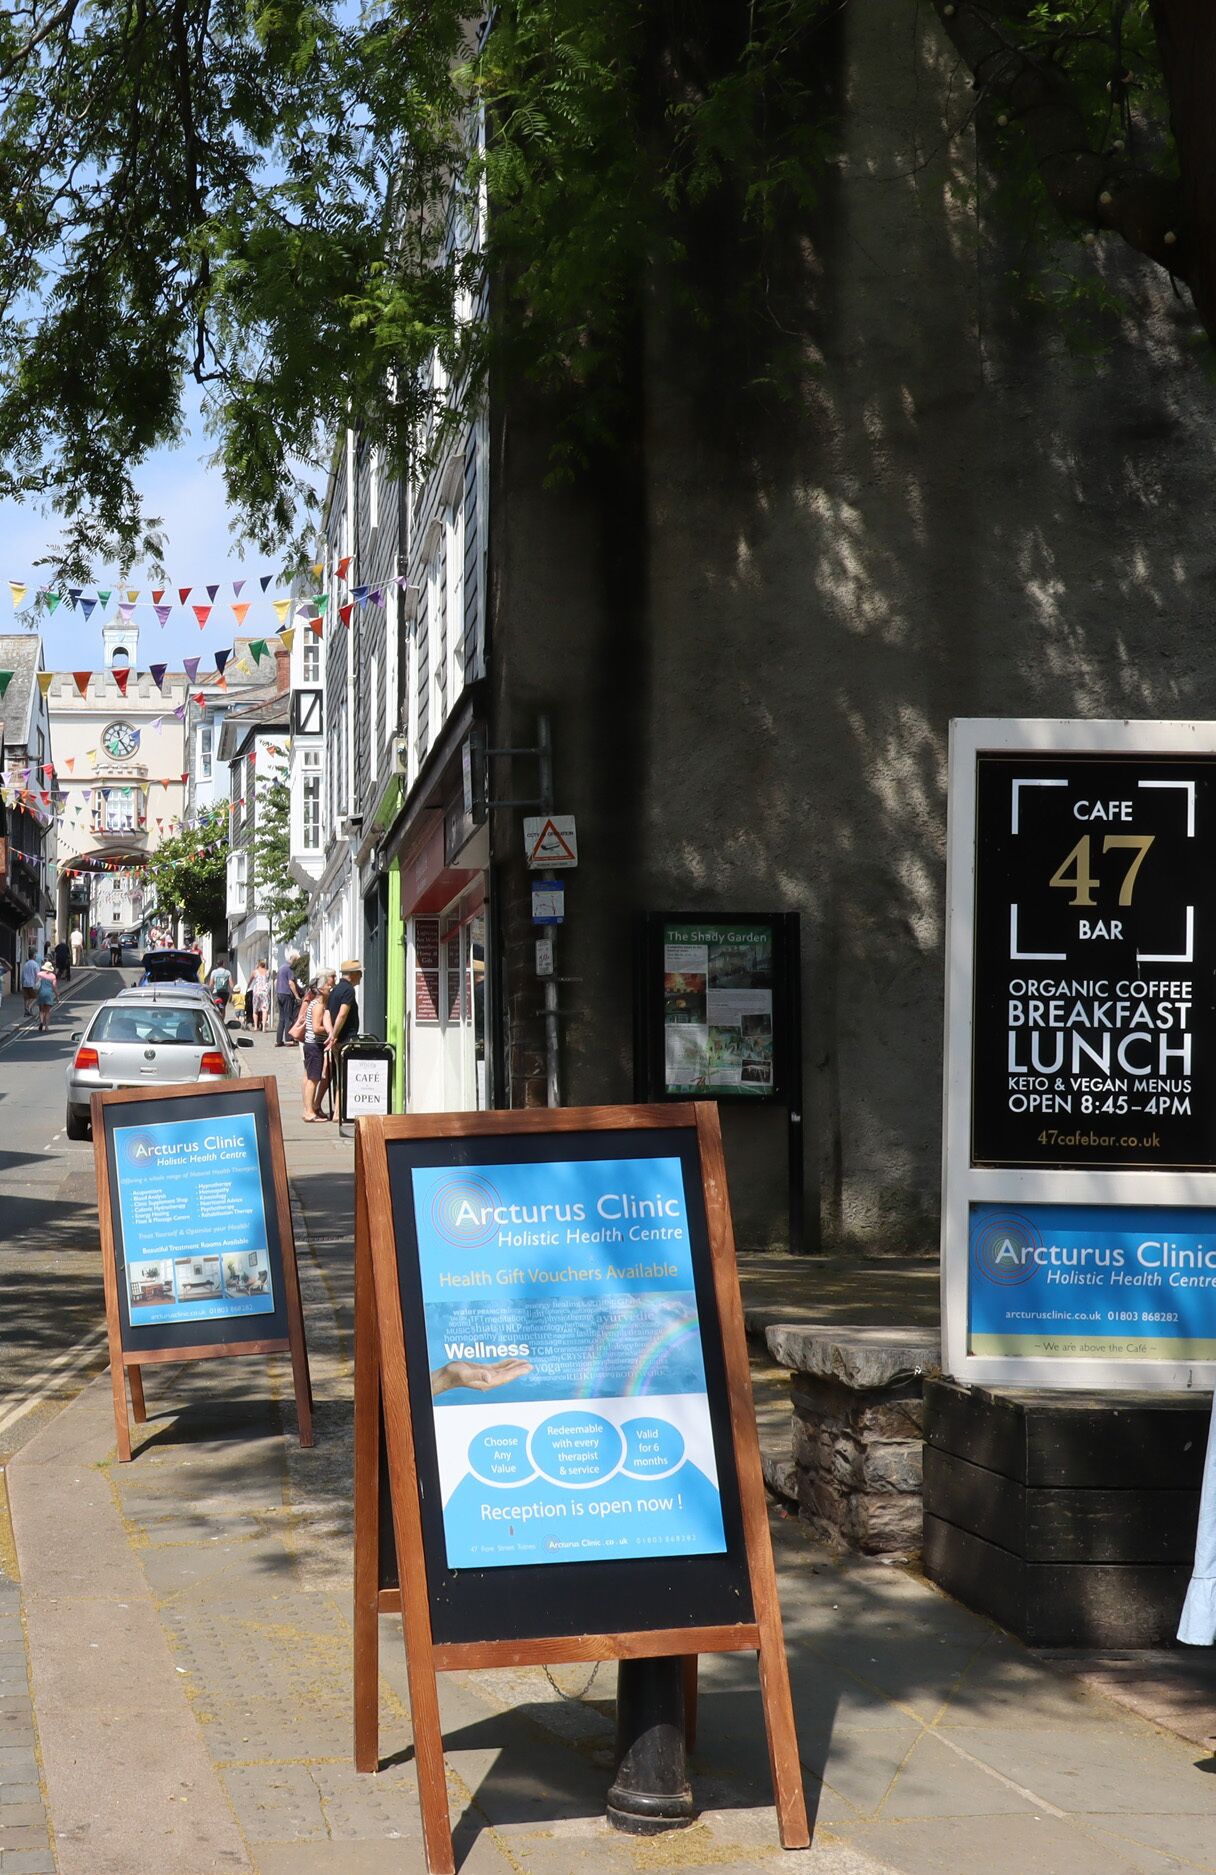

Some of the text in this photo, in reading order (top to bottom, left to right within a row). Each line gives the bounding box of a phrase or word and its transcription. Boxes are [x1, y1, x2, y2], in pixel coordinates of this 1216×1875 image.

[1073, 800, 1133, 821] CAFE
[1048, 834, 1155, 906] 47
[1078, 920, 1123, 940] BAR
[668, 931, 766, 944] The Shady Garden
[1009, 980, 1192, 998] ORGANIC COFFEE
[1008, 1000, 1192, 1029] BREAKFAST
[1008, 1030, 1191, 1076] LUNCH
[355, 1072, 380, 1082] CAFÉ
[1008, 1077, 1192, 1094] KETO & VEGAN MENUS
[354, 1094, 380, 1104] OPEN
[1008, 1094, 1072, 1114] OPEN
[1038, 1130, 1160, 1148] 47cafebar.co.uk
[136, 1135, 244, 1158] Arcturus Clinic
[157, 1150, 247, 1167] Holistic Health Centre
[455, 1194, 680, 1226] Arcturus Clinic
[498, 1226, 683, 1248] Holistic Health Centre
[995, 1239, 1216, 1269] Arcturus Clinic
[440, 1263, 678, 1287] Health Gift Vouchers Available
[1047, 1270, 1216, 1288] Holistic Health Centre
[1006, 1310, 1179, 1322] arcturusclinic.co.uk 01803 868282
[506, 1324, 522, 1333] NLP
[444, 1332, 552, 1342] homeopathy acupuncture
[444, 1342, 530, 1360] Wellness
[532, 1347, 553, 1356] TCM
[1043, 1342, 1148, 1353] We are above the Café
[535, 1362, 561, 1376] yoga
[547, 1424, 603, 1436] Redeemable
[636, 1430, 659, 1440] Valid
[484, 1436, 518, 1447] Choose
[552, 1439, 599, 1452] with every
[639, 1442, 660, 1452] for 6
[494, 1451, 512, 1462] Any
[558, 1450, 598, 1464] therapist
[634, 1456, 668, 1466] months
[491, 1464, 516, 1474] Value
[560, 1465, 600, 1476] & service
[481, 1494, 683, 1523] Reception is open now !
[549, 1540, 580, 1551] Arcturus
